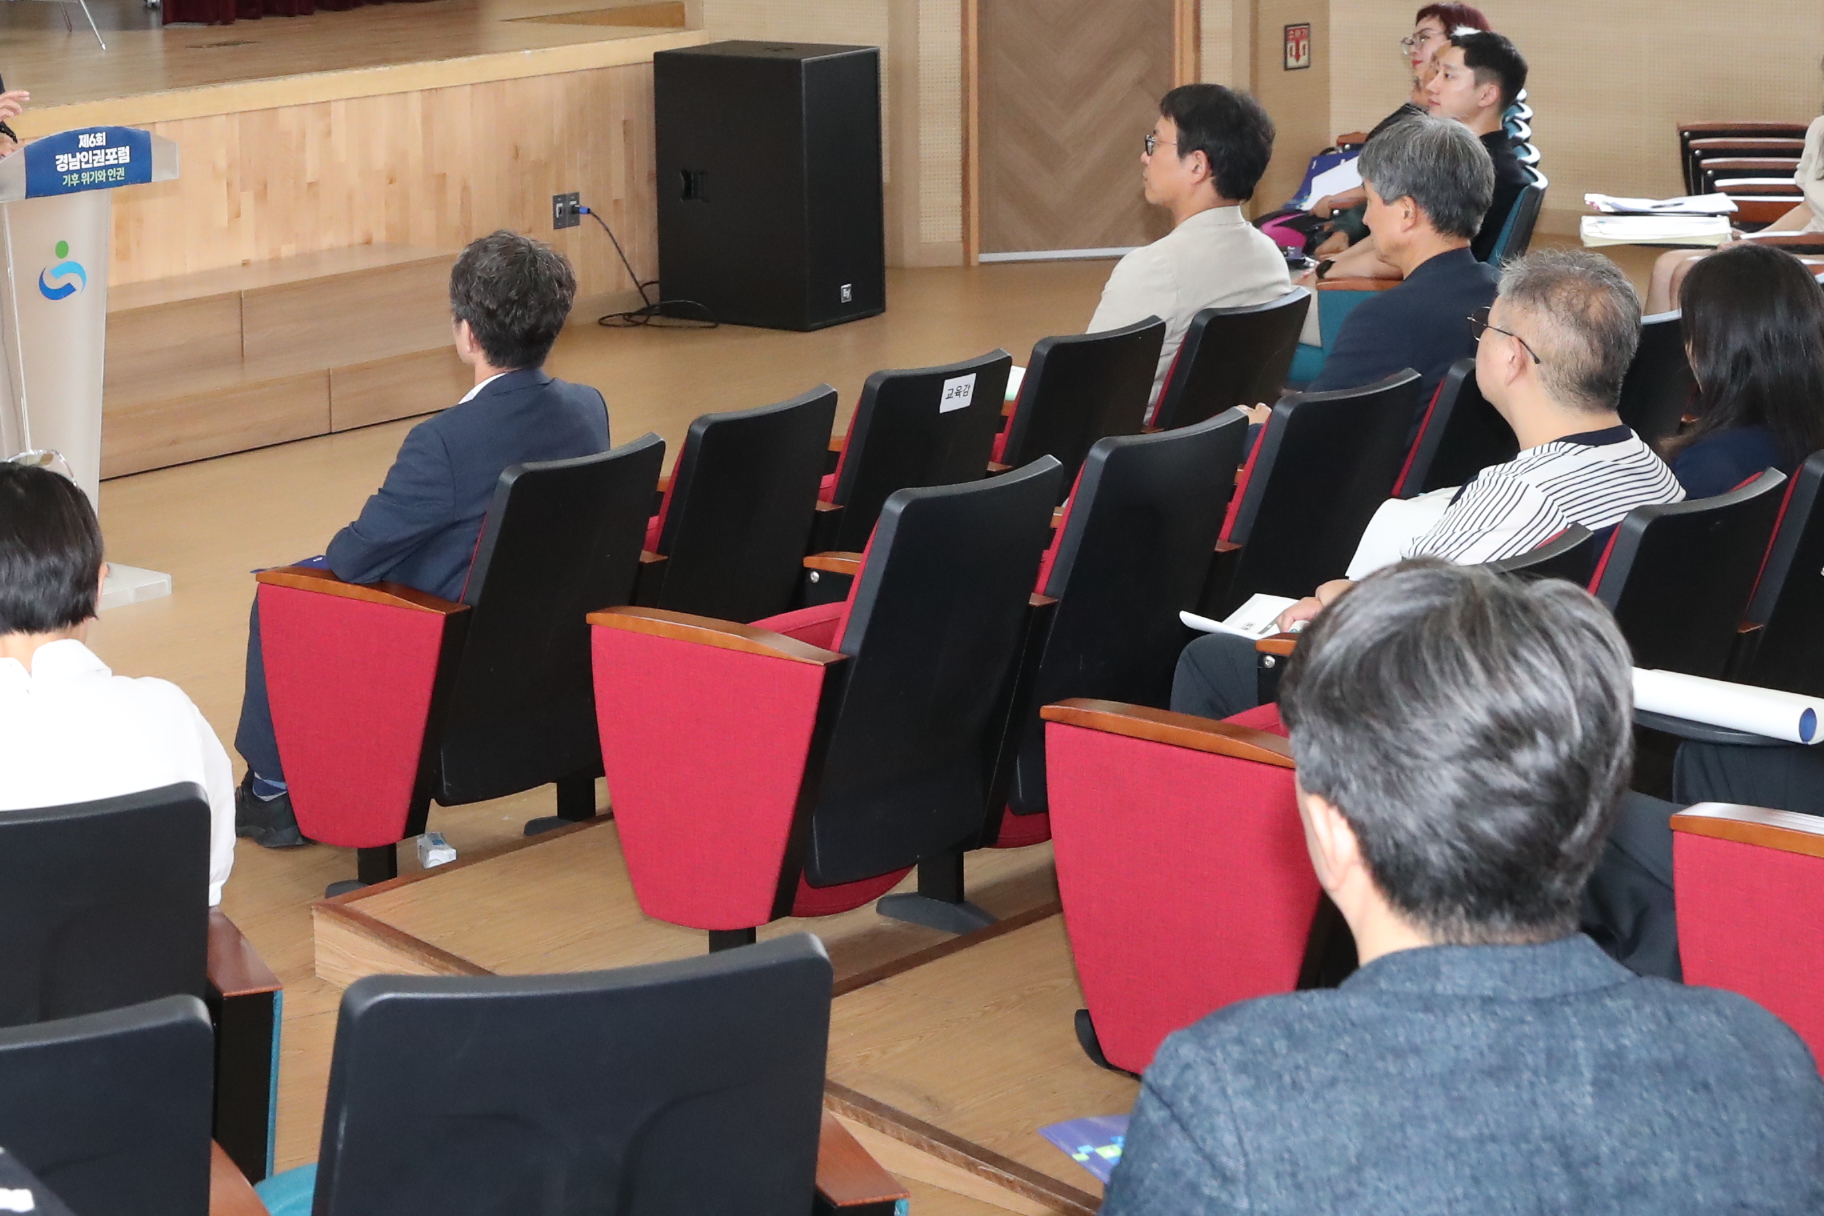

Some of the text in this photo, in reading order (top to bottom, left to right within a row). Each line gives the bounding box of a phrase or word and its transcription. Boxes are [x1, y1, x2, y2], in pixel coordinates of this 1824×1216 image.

[78, 131, 107, 148] 제6회
[55, 145, 131, 172] 경남인권포럼
[107, 167, 125, 181] 인권
[944, 383, 971, 400] 교육감
